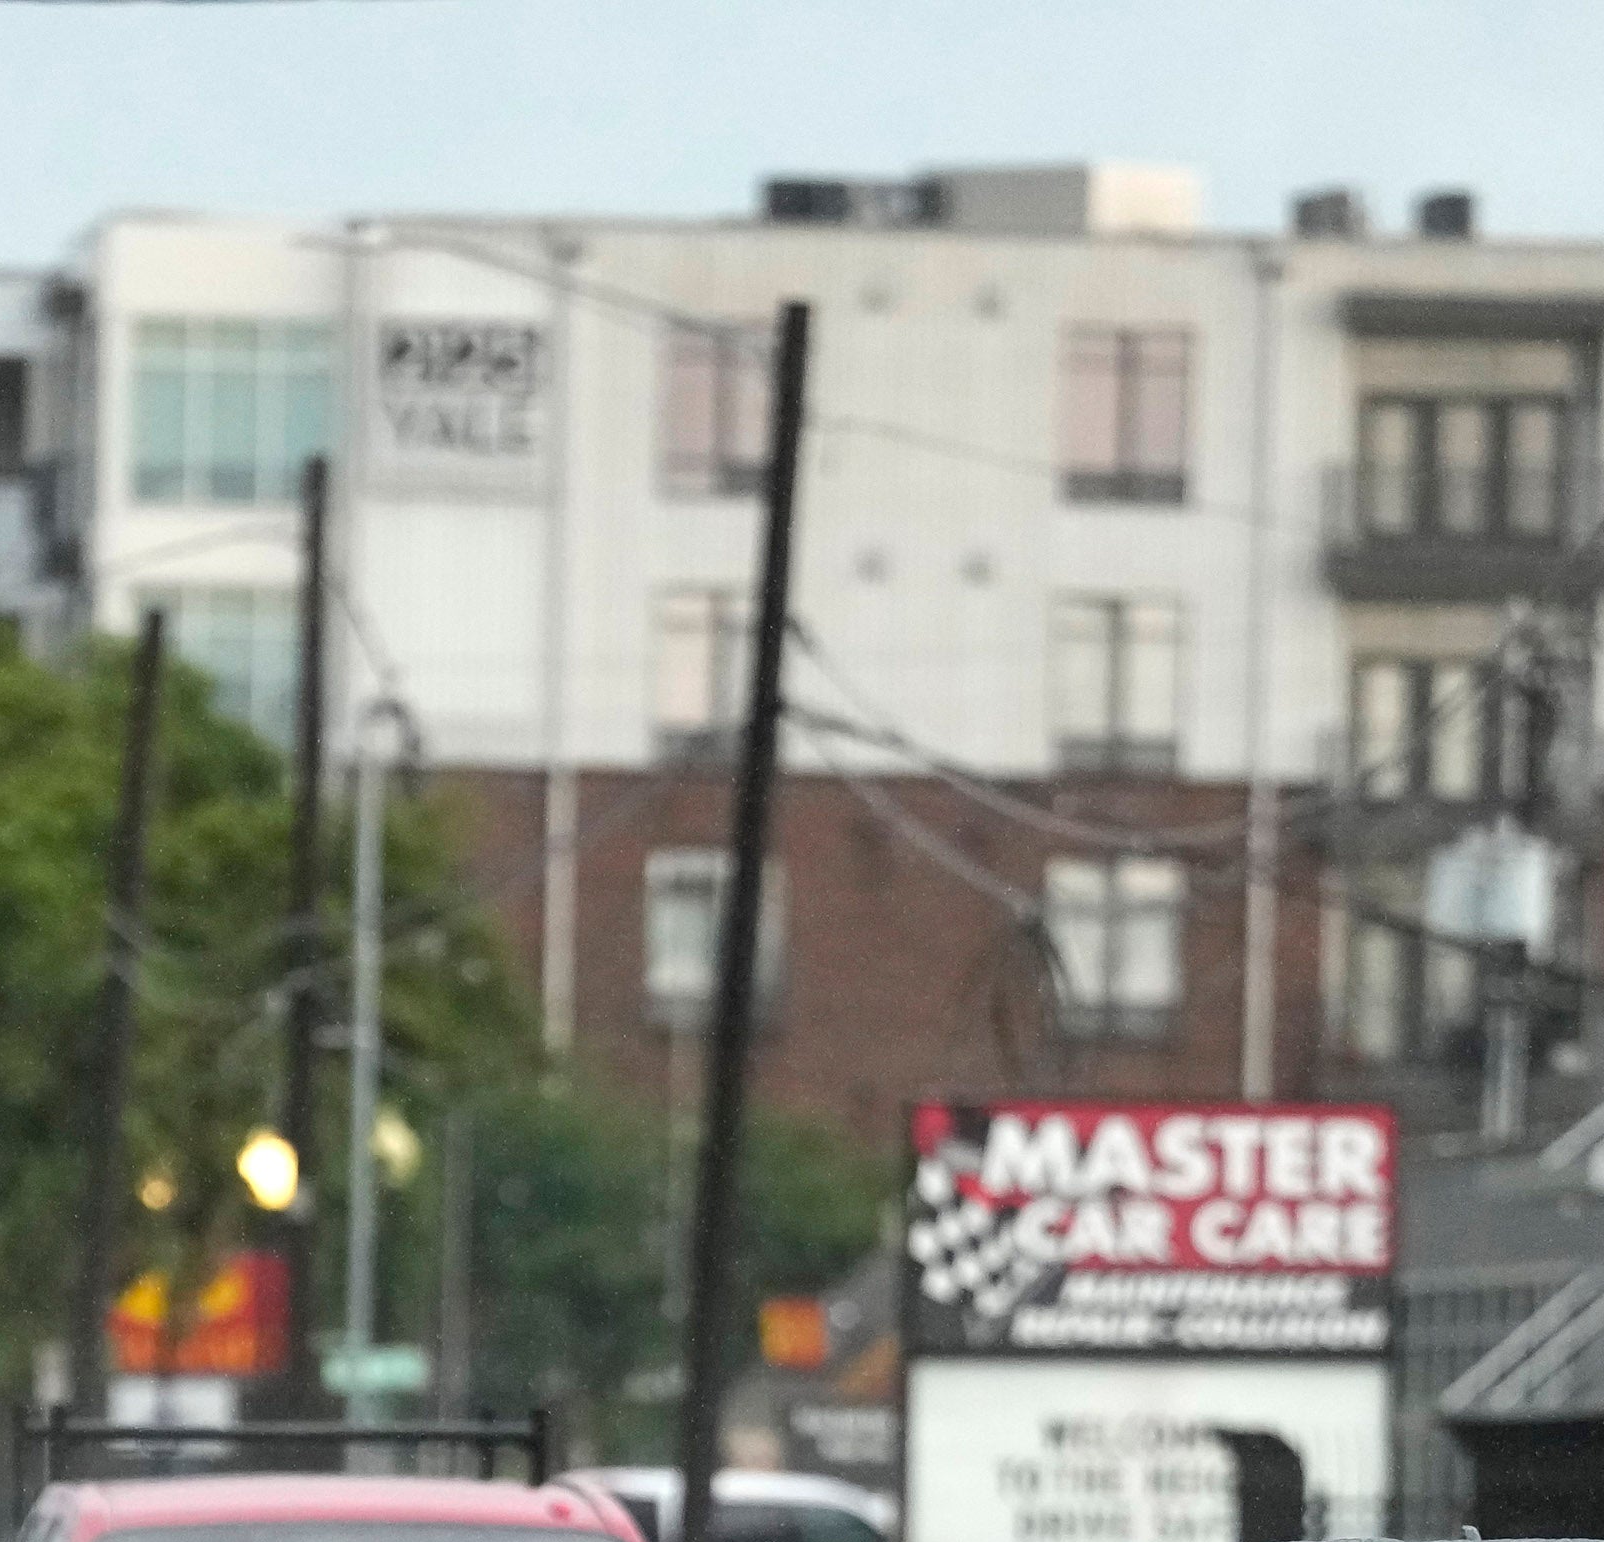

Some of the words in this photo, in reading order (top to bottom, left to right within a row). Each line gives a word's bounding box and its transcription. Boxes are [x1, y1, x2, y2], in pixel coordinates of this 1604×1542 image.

[979, 1115, 1386, 1198] MASTER
[1013, 1200, 1172, 1263] CAR
[1189, 1202, 1388, 1265] CARE
[1013, 1510, 1131, 1542] DRIVE
